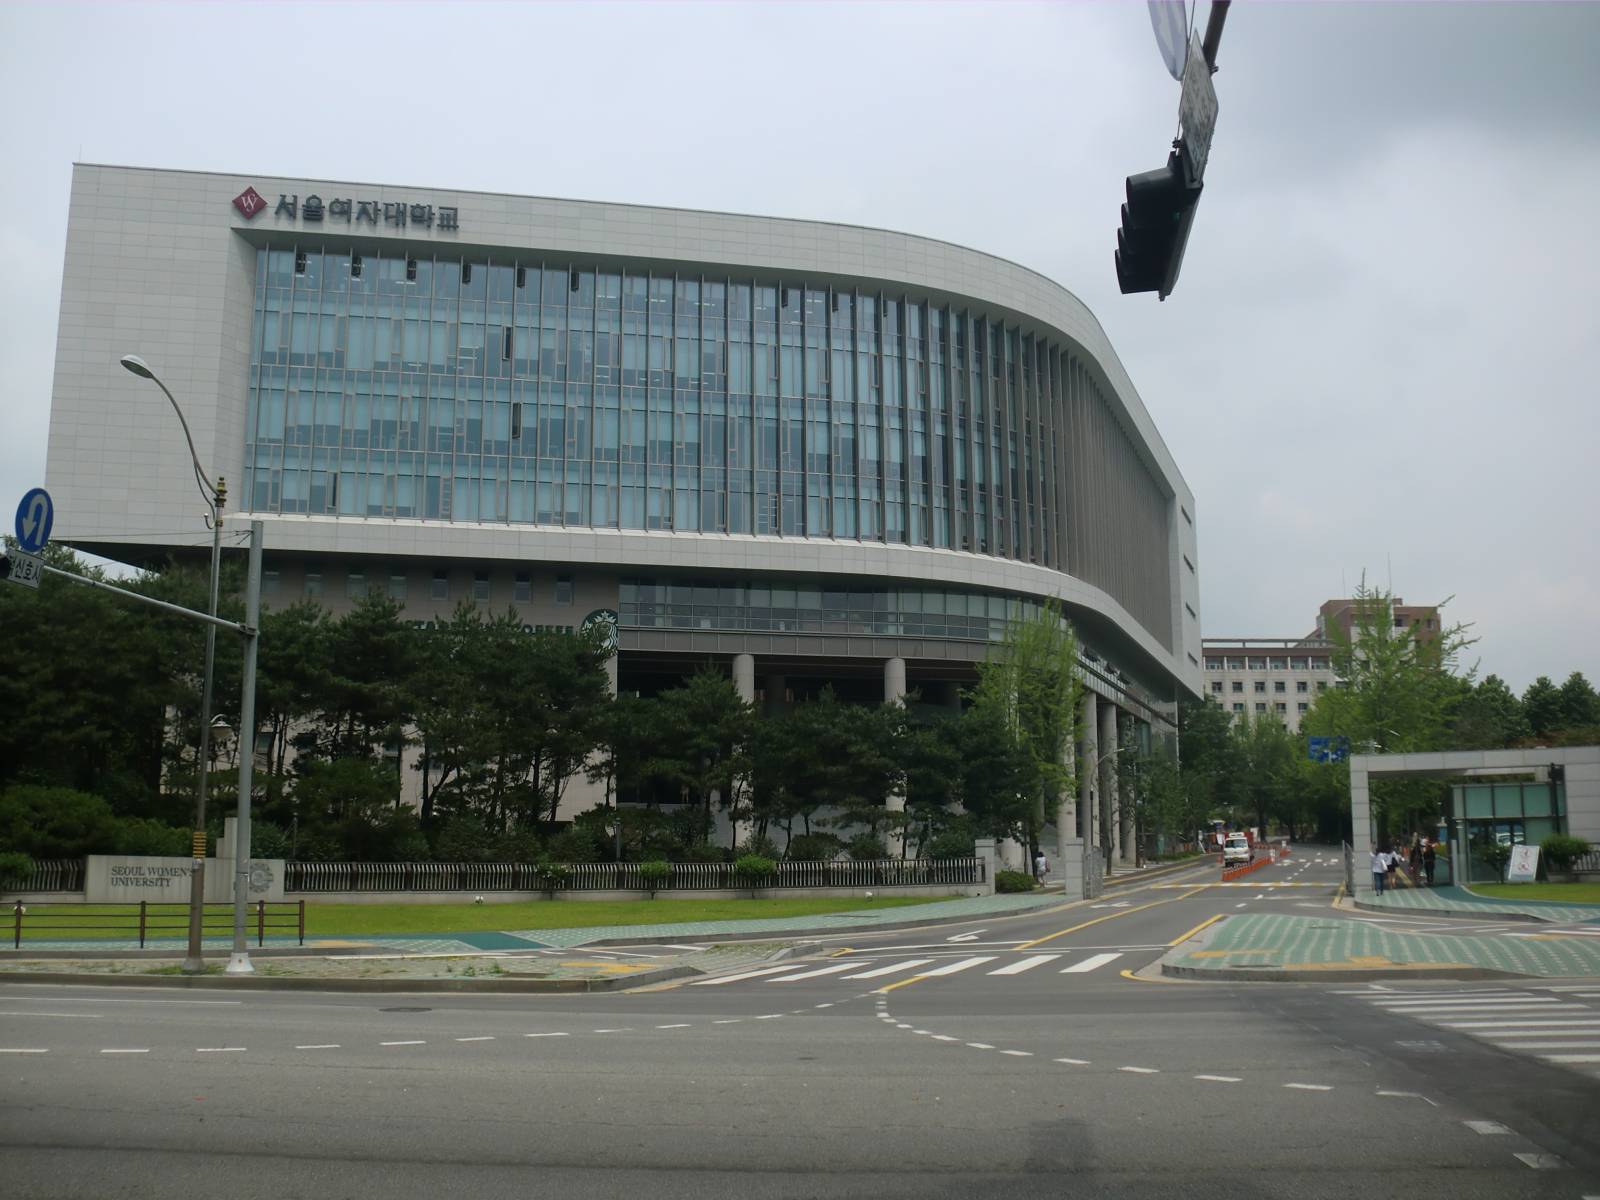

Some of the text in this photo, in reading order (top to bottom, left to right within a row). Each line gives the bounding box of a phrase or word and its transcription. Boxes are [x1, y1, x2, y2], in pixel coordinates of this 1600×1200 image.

[274, 194, 458, 230] 서울여자대학교
[111, 866, 145, 877] SEOUL
[111, 878, 172, 888] UNIVERSITY
